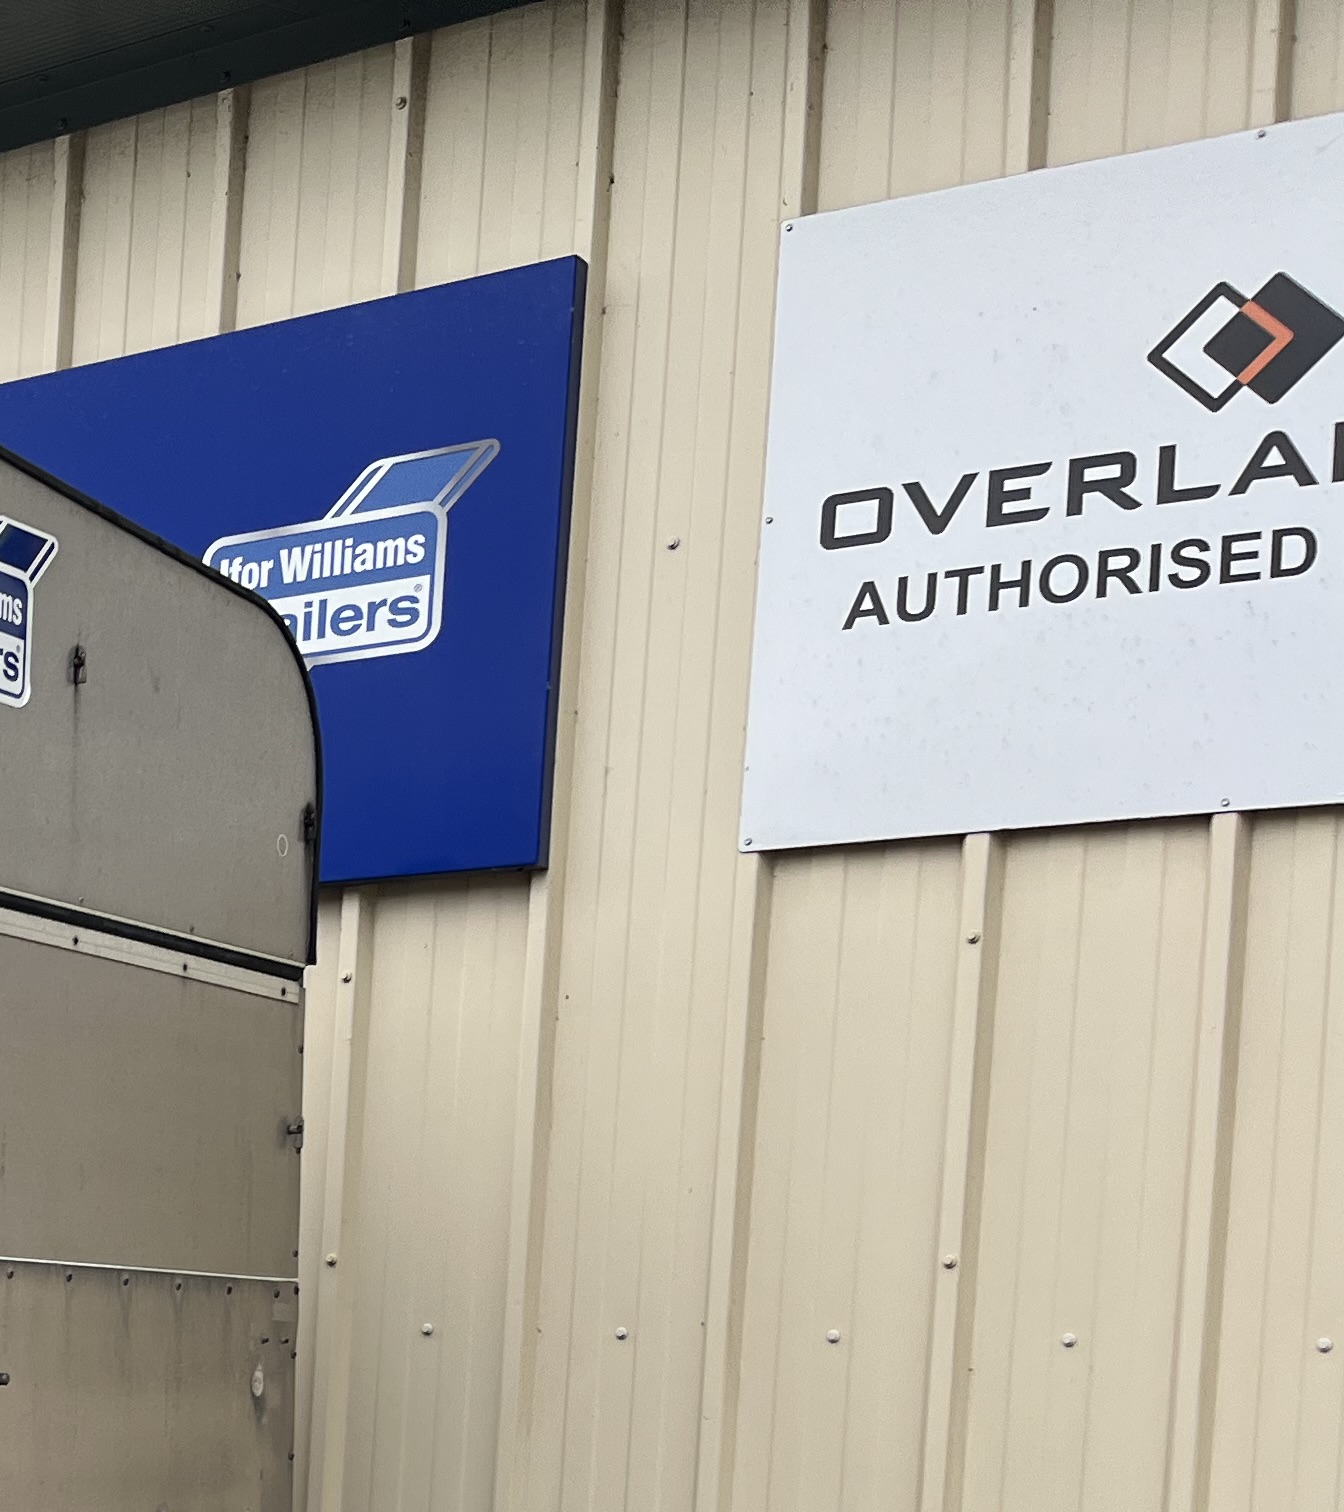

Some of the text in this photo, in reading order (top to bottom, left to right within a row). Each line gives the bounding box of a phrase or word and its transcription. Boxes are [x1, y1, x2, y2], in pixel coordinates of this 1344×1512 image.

[280, 533, 426, 584] Williams
[842, 526, 1319, 631] AUTHORISED
[278, 595, 422, 642] ailers
